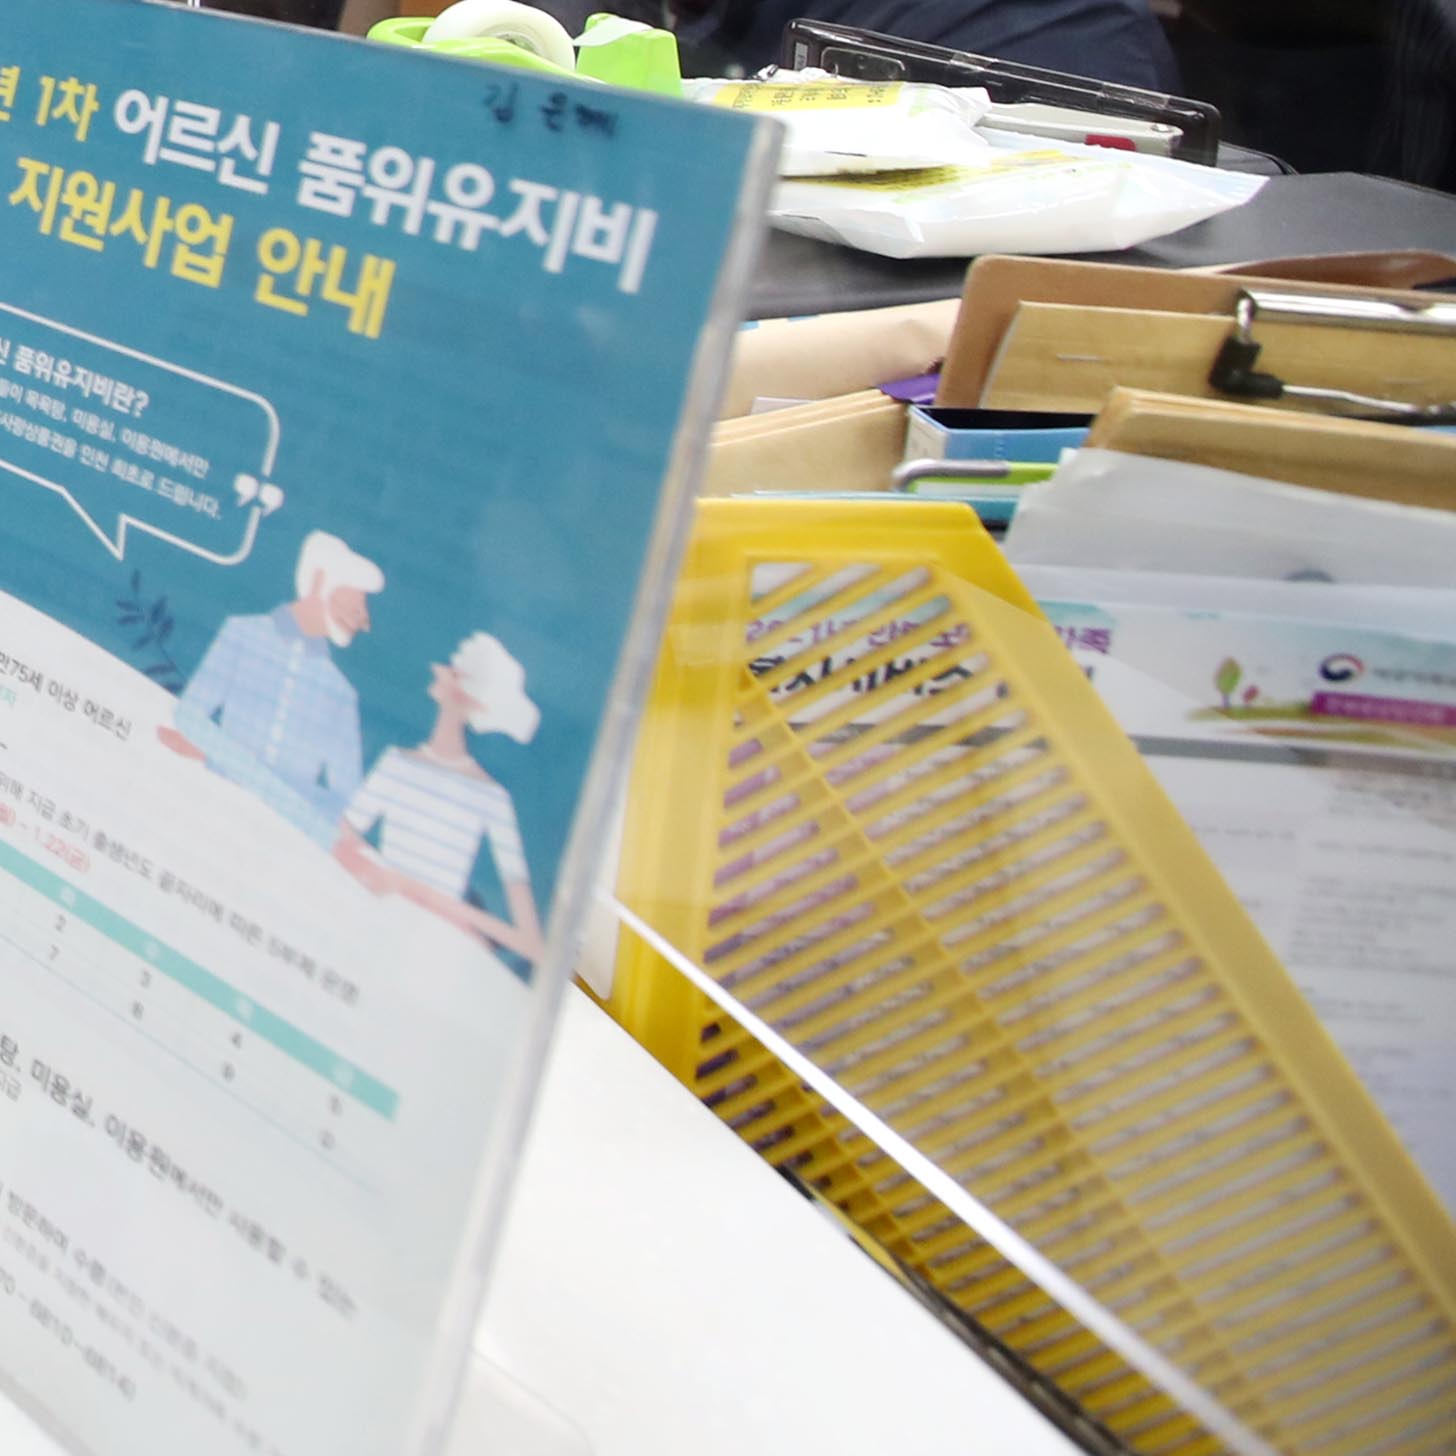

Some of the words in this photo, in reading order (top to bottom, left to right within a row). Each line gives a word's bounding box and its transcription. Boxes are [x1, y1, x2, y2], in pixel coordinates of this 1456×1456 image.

[8, 157, 236, 288] 지원사업
[253, 229, 397, 341] 안내
[37, 75, 100, 144] 1차
[112, 87, 281, 196] 어르신
[297, 130, 659, 296] 품위유지비
[14, 345, 149, 418] 품위유지비란?
[48, 680, 79, 712] 이상
[84, 699, 132, 741] 어르신
